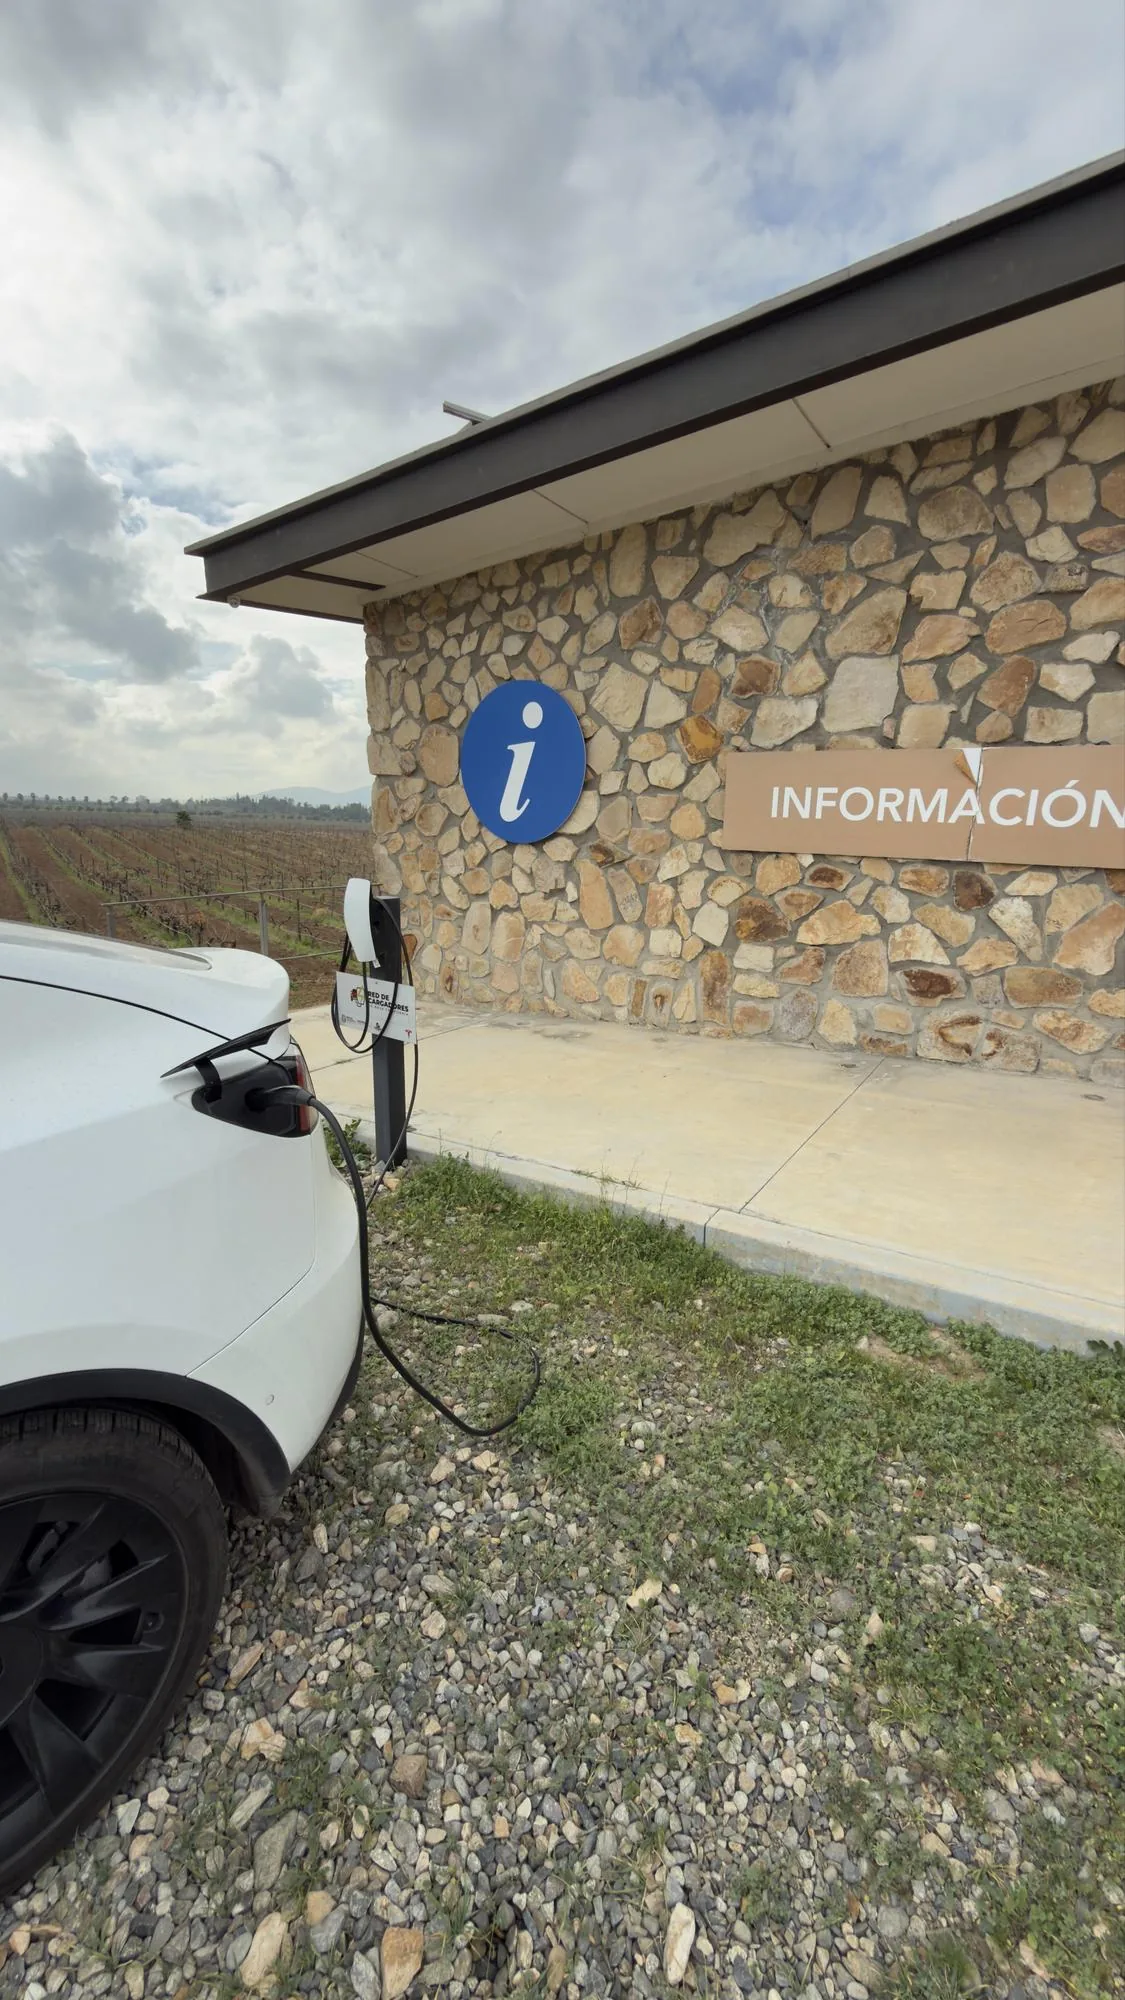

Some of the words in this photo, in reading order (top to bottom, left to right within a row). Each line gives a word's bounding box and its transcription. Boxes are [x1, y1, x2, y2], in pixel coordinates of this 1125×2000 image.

[499, 701, 544, 823] i
[770, 779, 1125, 829] INFORMACIÓN
[367, 991, 380, 999] RED
